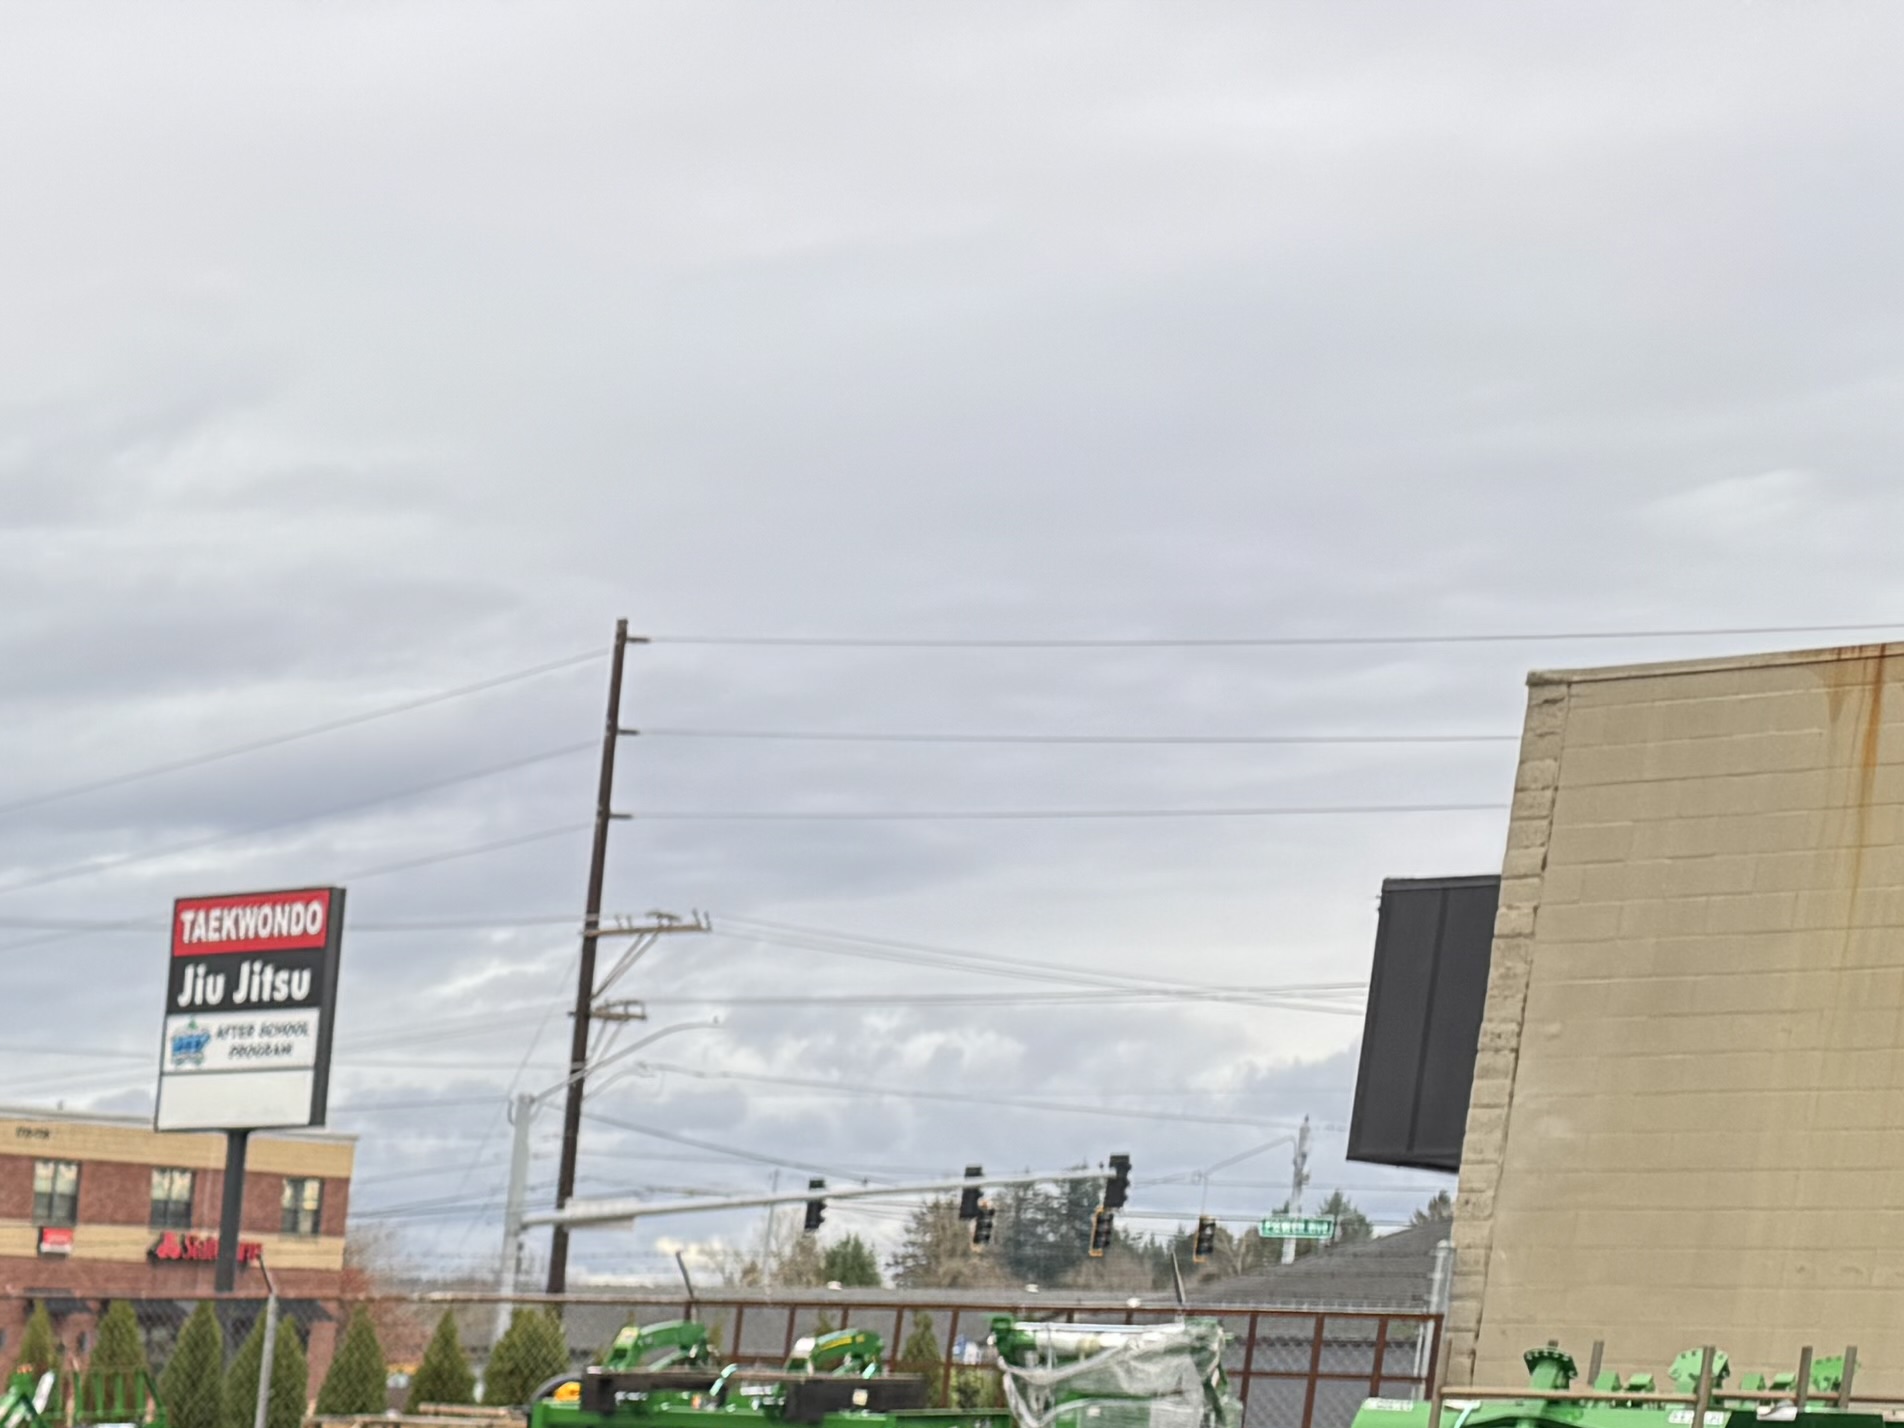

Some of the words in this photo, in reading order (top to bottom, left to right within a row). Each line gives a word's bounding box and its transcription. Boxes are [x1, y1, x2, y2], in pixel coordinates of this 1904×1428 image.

[180, 899, 324, 944] TAEKWONDO
[177, 962, 225, 1007] Jiu
[232, 959, 312, 1005] Jitsu
